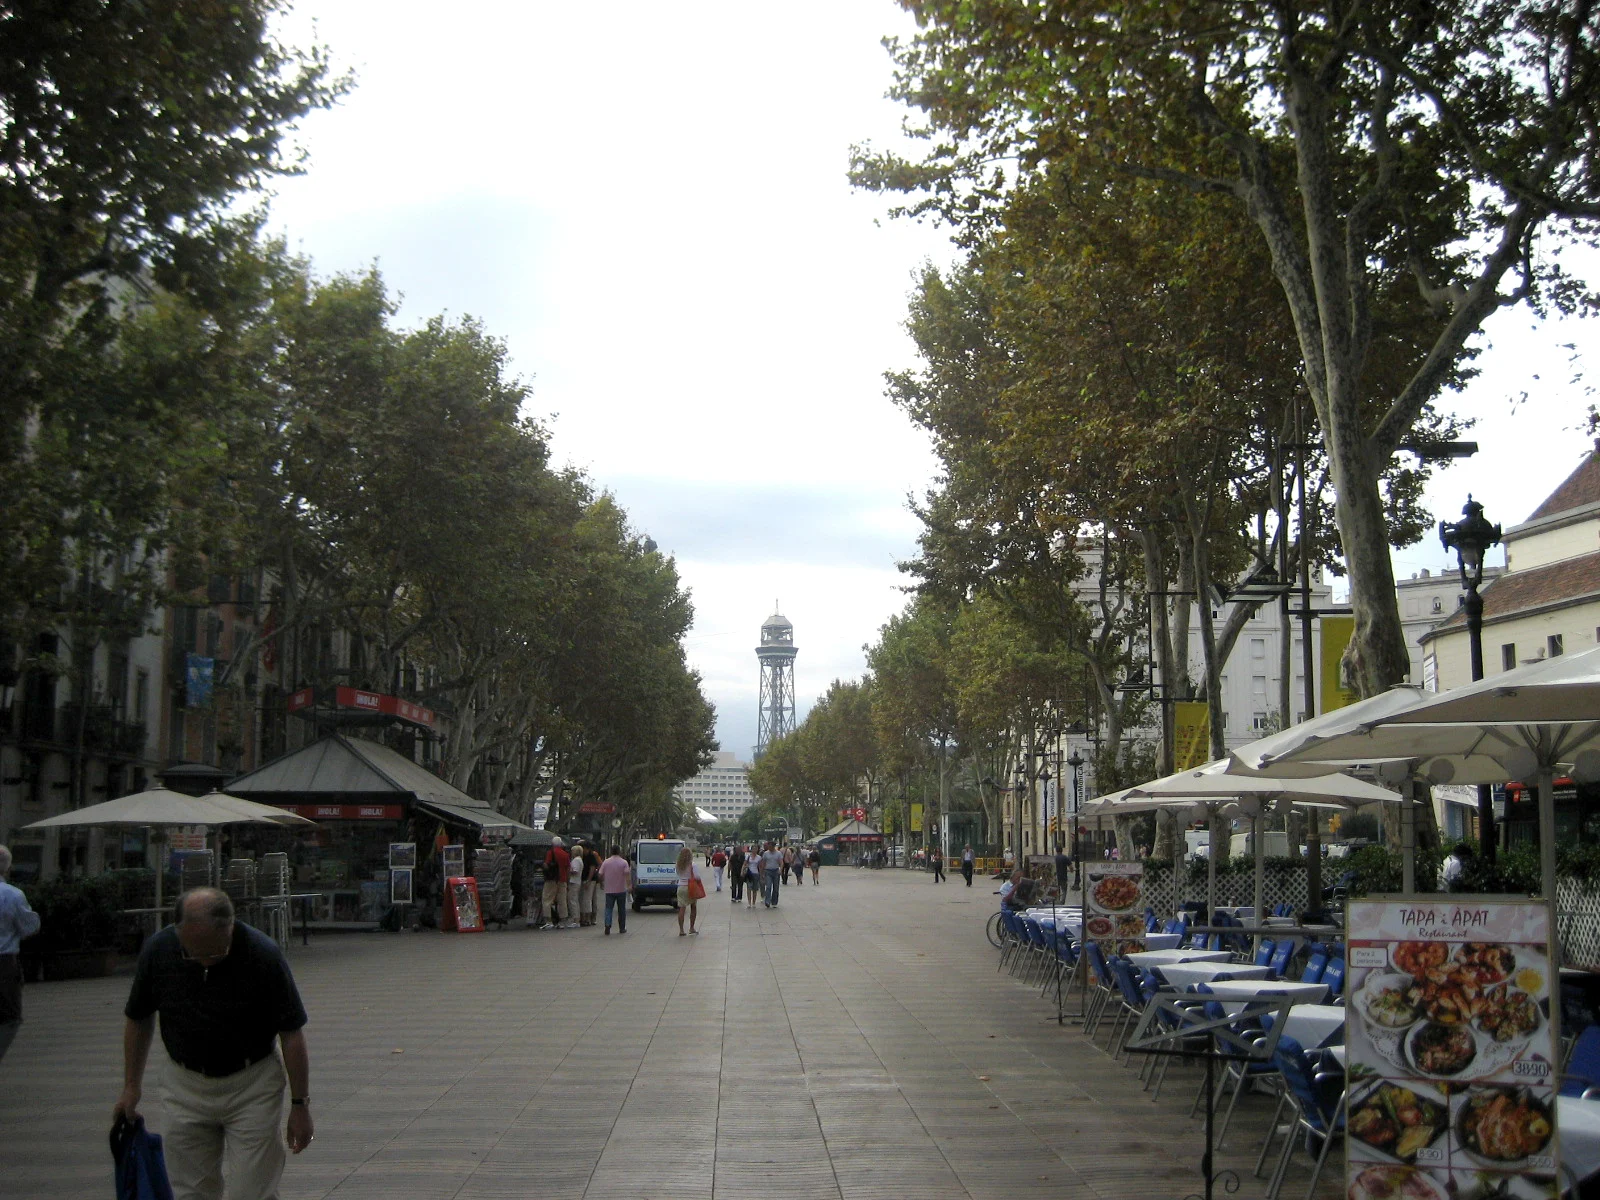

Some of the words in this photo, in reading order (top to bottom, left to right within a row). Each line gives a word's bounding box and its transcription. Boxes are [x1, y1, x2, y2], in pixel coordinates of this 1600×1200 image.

[1400, 909, 1435, 926] TAPA
[1441, 913, 1448, 925] i
[1451, 906, 1489, 926] ÀPAT
[1418, 927, 1468, 938] Restaurant
